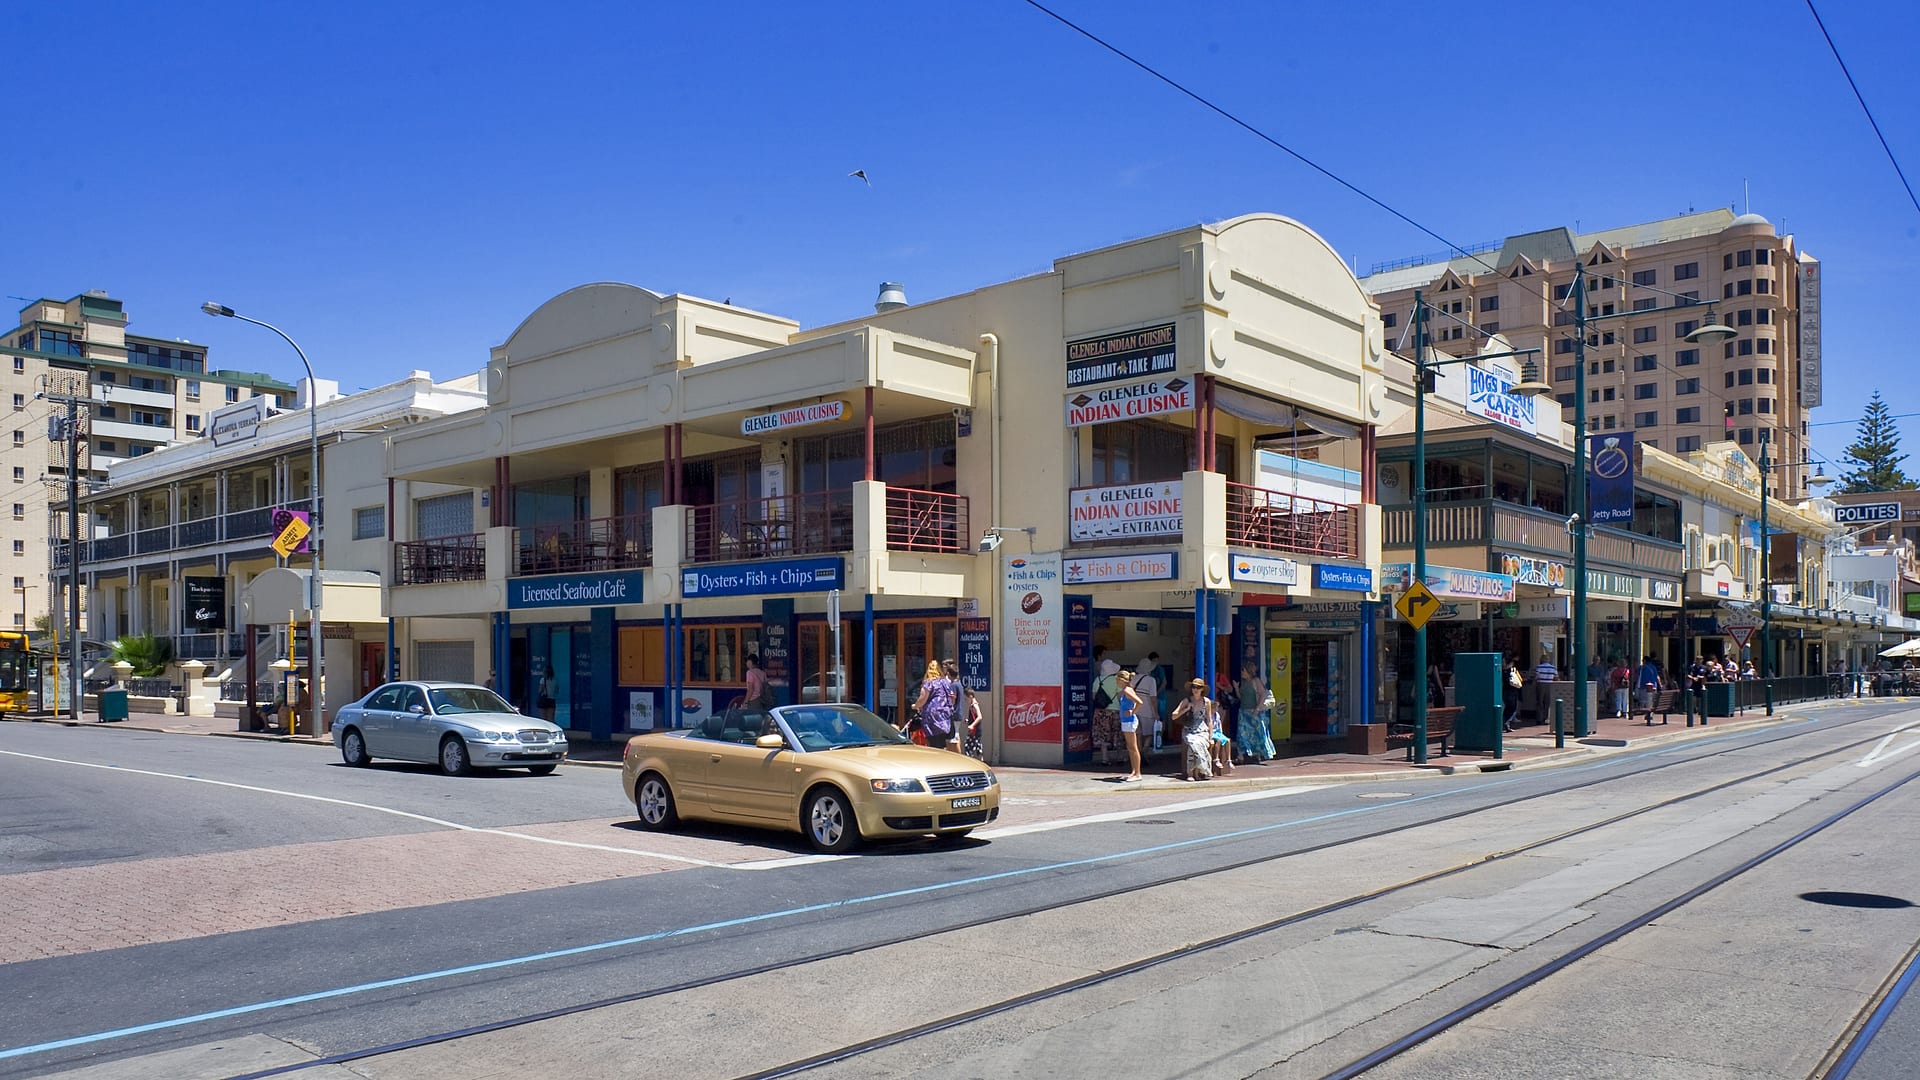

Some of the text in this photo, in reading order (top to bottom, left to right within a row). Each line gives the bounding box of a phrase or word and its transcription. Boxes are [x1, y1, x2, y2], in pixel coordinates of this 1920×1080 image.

[1070, 327, 1172, 359] GLENELG INDIAN CUISINE
[1068, 352, 1174, 384] RESTAURANT TAKE AWAY
[1099, 382, 1158, 403] GLENELG
[1070, 392, 1190, 425] INDIAN CUISINE
[1487, 393, 1519, 419] CAFE
[745, 402, 840, 432] GLENELG INDIAN CUISINE
[1100, 487, 1153, 502] GLENELG
[1074, 498, 1182, 521] INDIAN CUISINE
[1593, 508, 1631, 519] Jetty Road
[1837, 505, 1896, 521] POLITES
[1122, 519, 1183, 534] ENTRANCE
[282, 527, 297, 544] ADMIT
[1013, 569, 1056, 580] Fish & Chips
[1088, 560, 1166, 576] Fish & Chips
[1256, 565, 1277, 577] oyster
[1279, 561, 1294, 582] shop
[701, 574, 738, 592] Oysters
[746, 570, 767, 586] Fish
[781, 569, 812, 586] Chips
[1321, 571, 1339, 583] Oysters
[1342, 572, 1352, 583] Fish
[1357, 575, 1370, 586] Chips
[1450, 568, 1503, 597] MAKIS YIROS
[1614, 576, 1633, 593] DISCS
[522, 578, 626, 602] Licensed Seafood Café
[1013, 583, 1038, 592] Oysters
[1655, 581, 1672, 599] SHADES
[1303, 602, 1335, 612] MAKIS
[766, 625, 785, 635] Coffin
[961, 621, 988, 631] FINALIST
[1014, 618, 1032, 627] Dine
[1034, 618, 1041, 626] in
[960, 632, 989, 641] Adelaide's
[1015, 628, 1049, 638] Takeaway
[769, 637, 781, 648] Bay
[968, 642, 980, 650] Best
[1018, 637, 1047, 645] Seafood
[765, 648, 787, 659] Oysters
[965, 652, 983, 663] Fish
[969, 664, 979, 675] 'n'
[962, 676, 987, 689] Chips
[1072, 692, 1085, 702] Best
